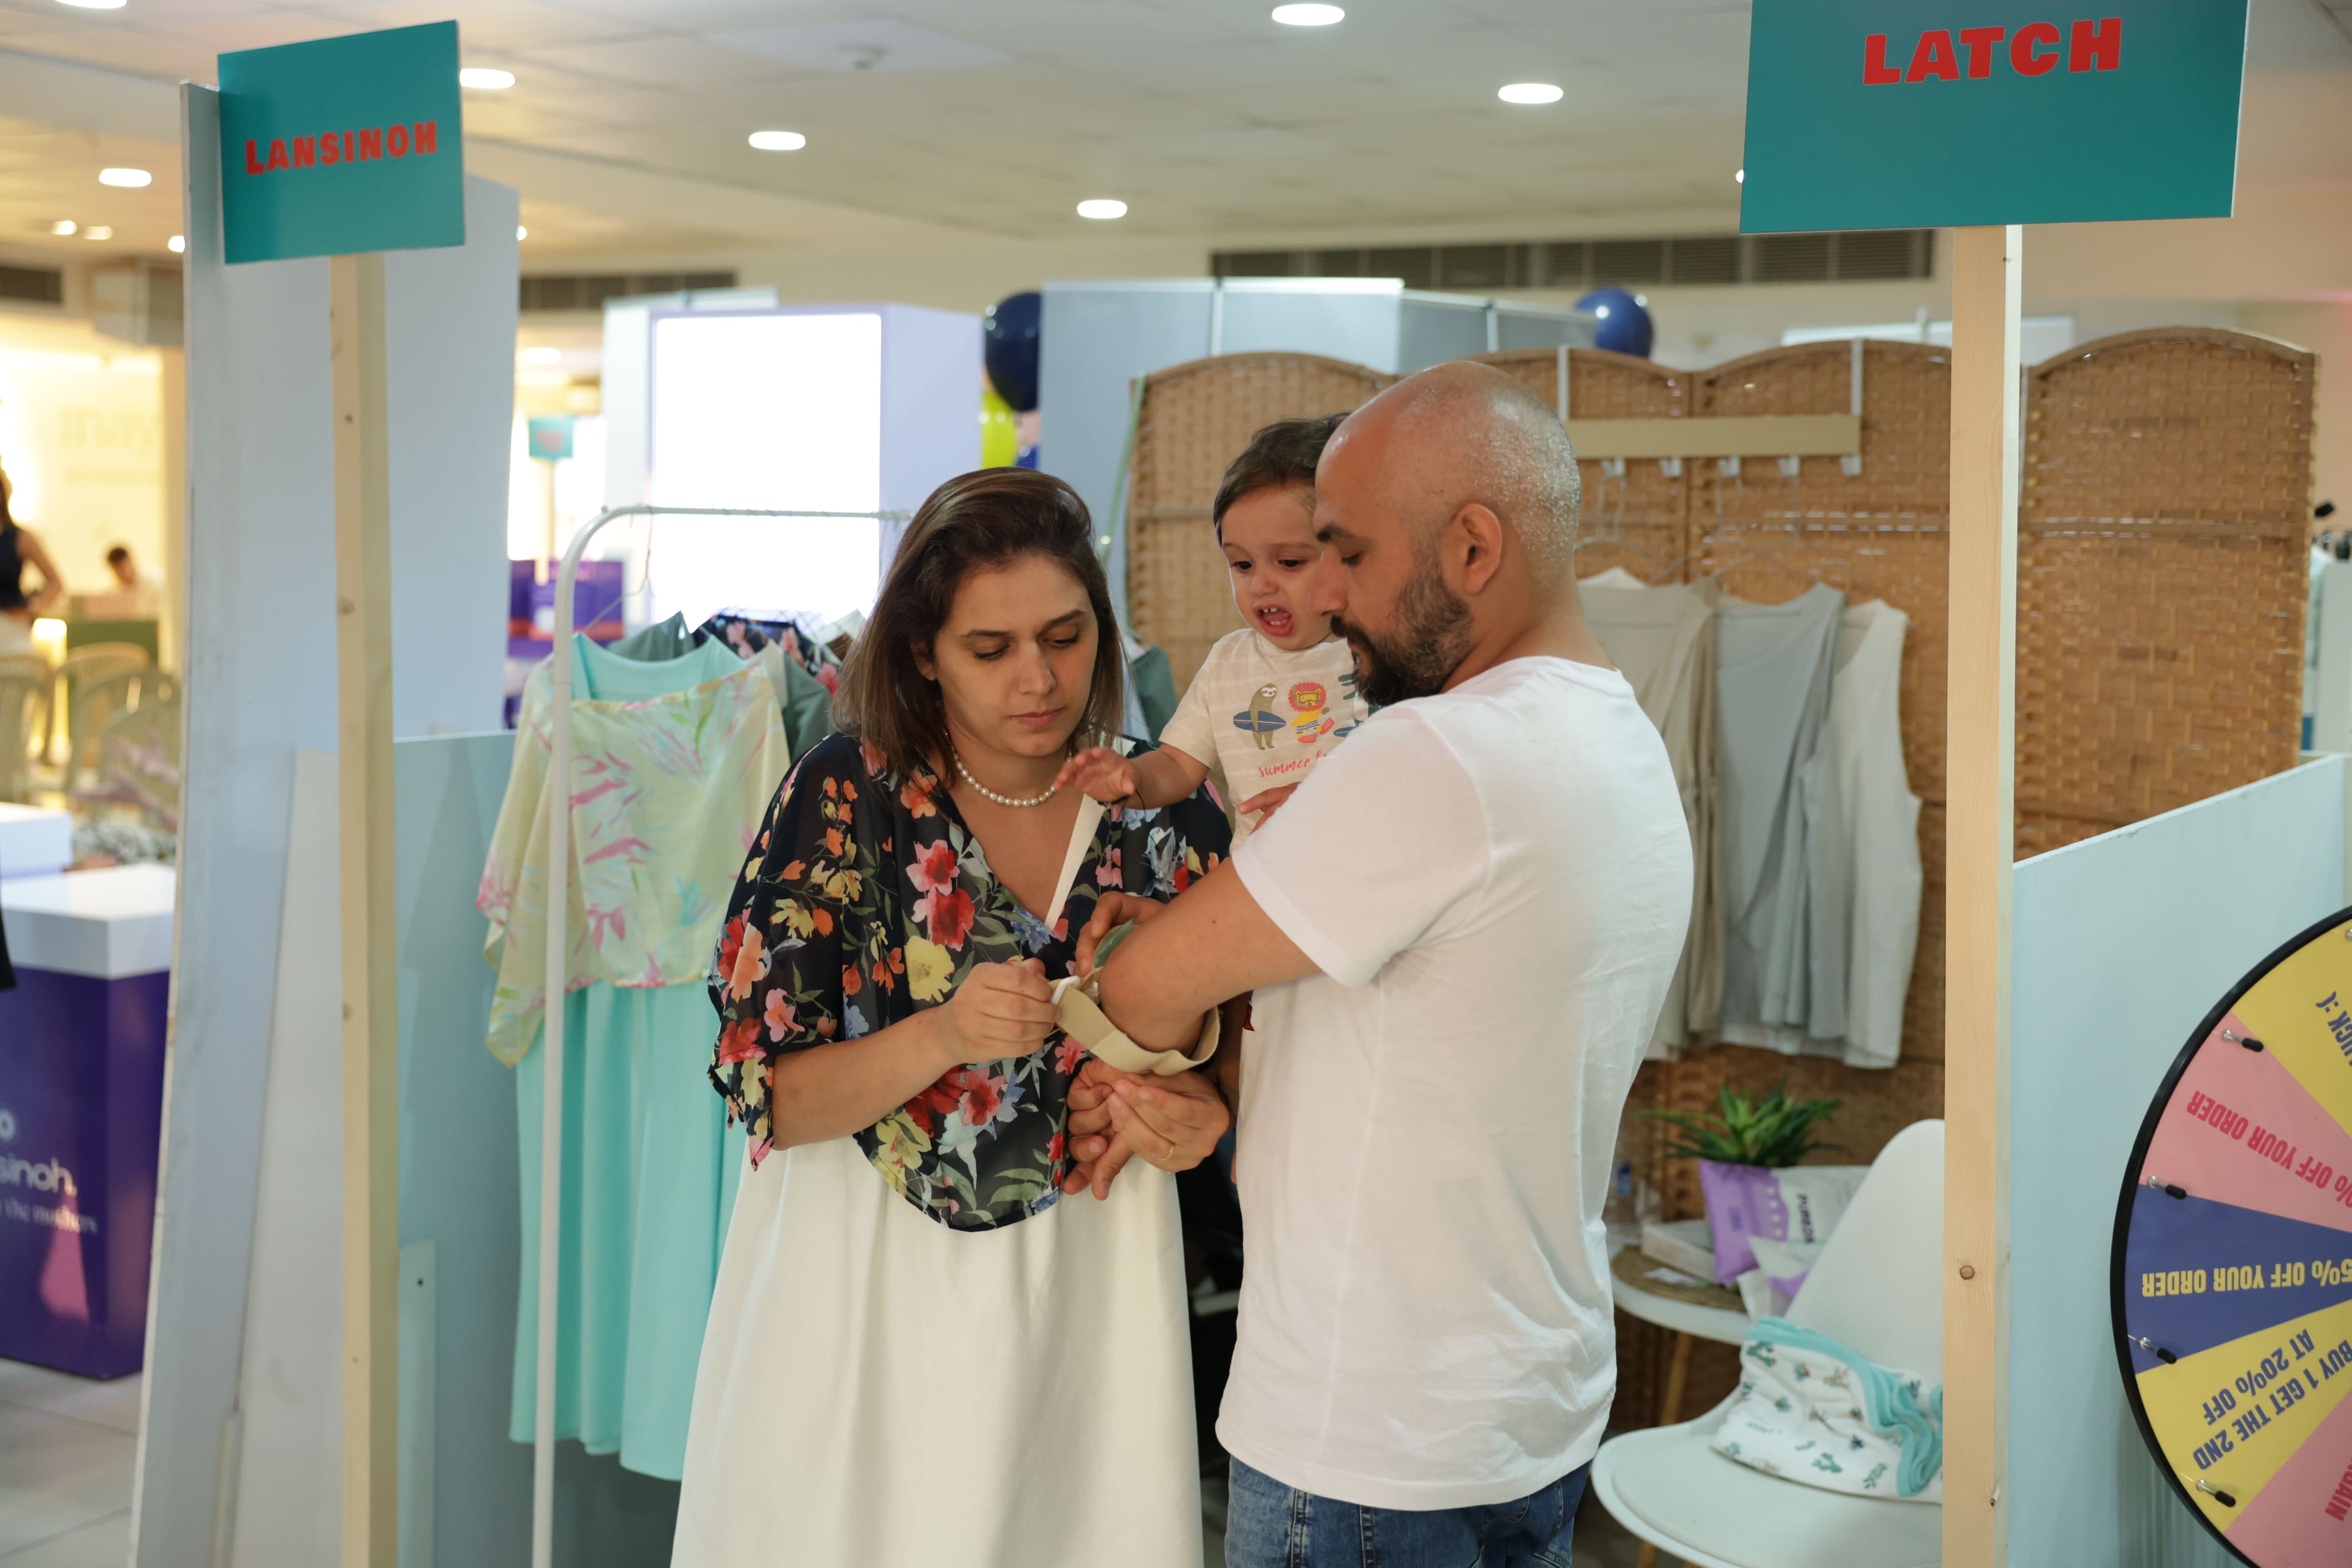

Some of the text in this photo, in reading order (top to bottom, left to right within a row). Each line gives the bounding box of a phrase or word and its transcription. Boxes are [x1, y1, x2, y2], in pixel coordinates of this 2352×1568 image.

[1863, 17, 2122, 85] LATCH
[246, 121, 437, 175] LANSINOH
[1258, 757, 1311, 778] summer
[2185, 1090, 2249, 1141] ORDER
[2247, 1126, 2297, 1170] YOUR
[2295, 1156, 2333, 1189] OFF
[2141, 1257, 2352, 1298] 5% OFF YOUR ORDER
[2203, 1329, 2316, 1425] AT 20% OFF
[2193, 1340, 2352, 1470] BUY 1 GET THE 2ND
[2324, 1459, 2352, 1521] GAIN
